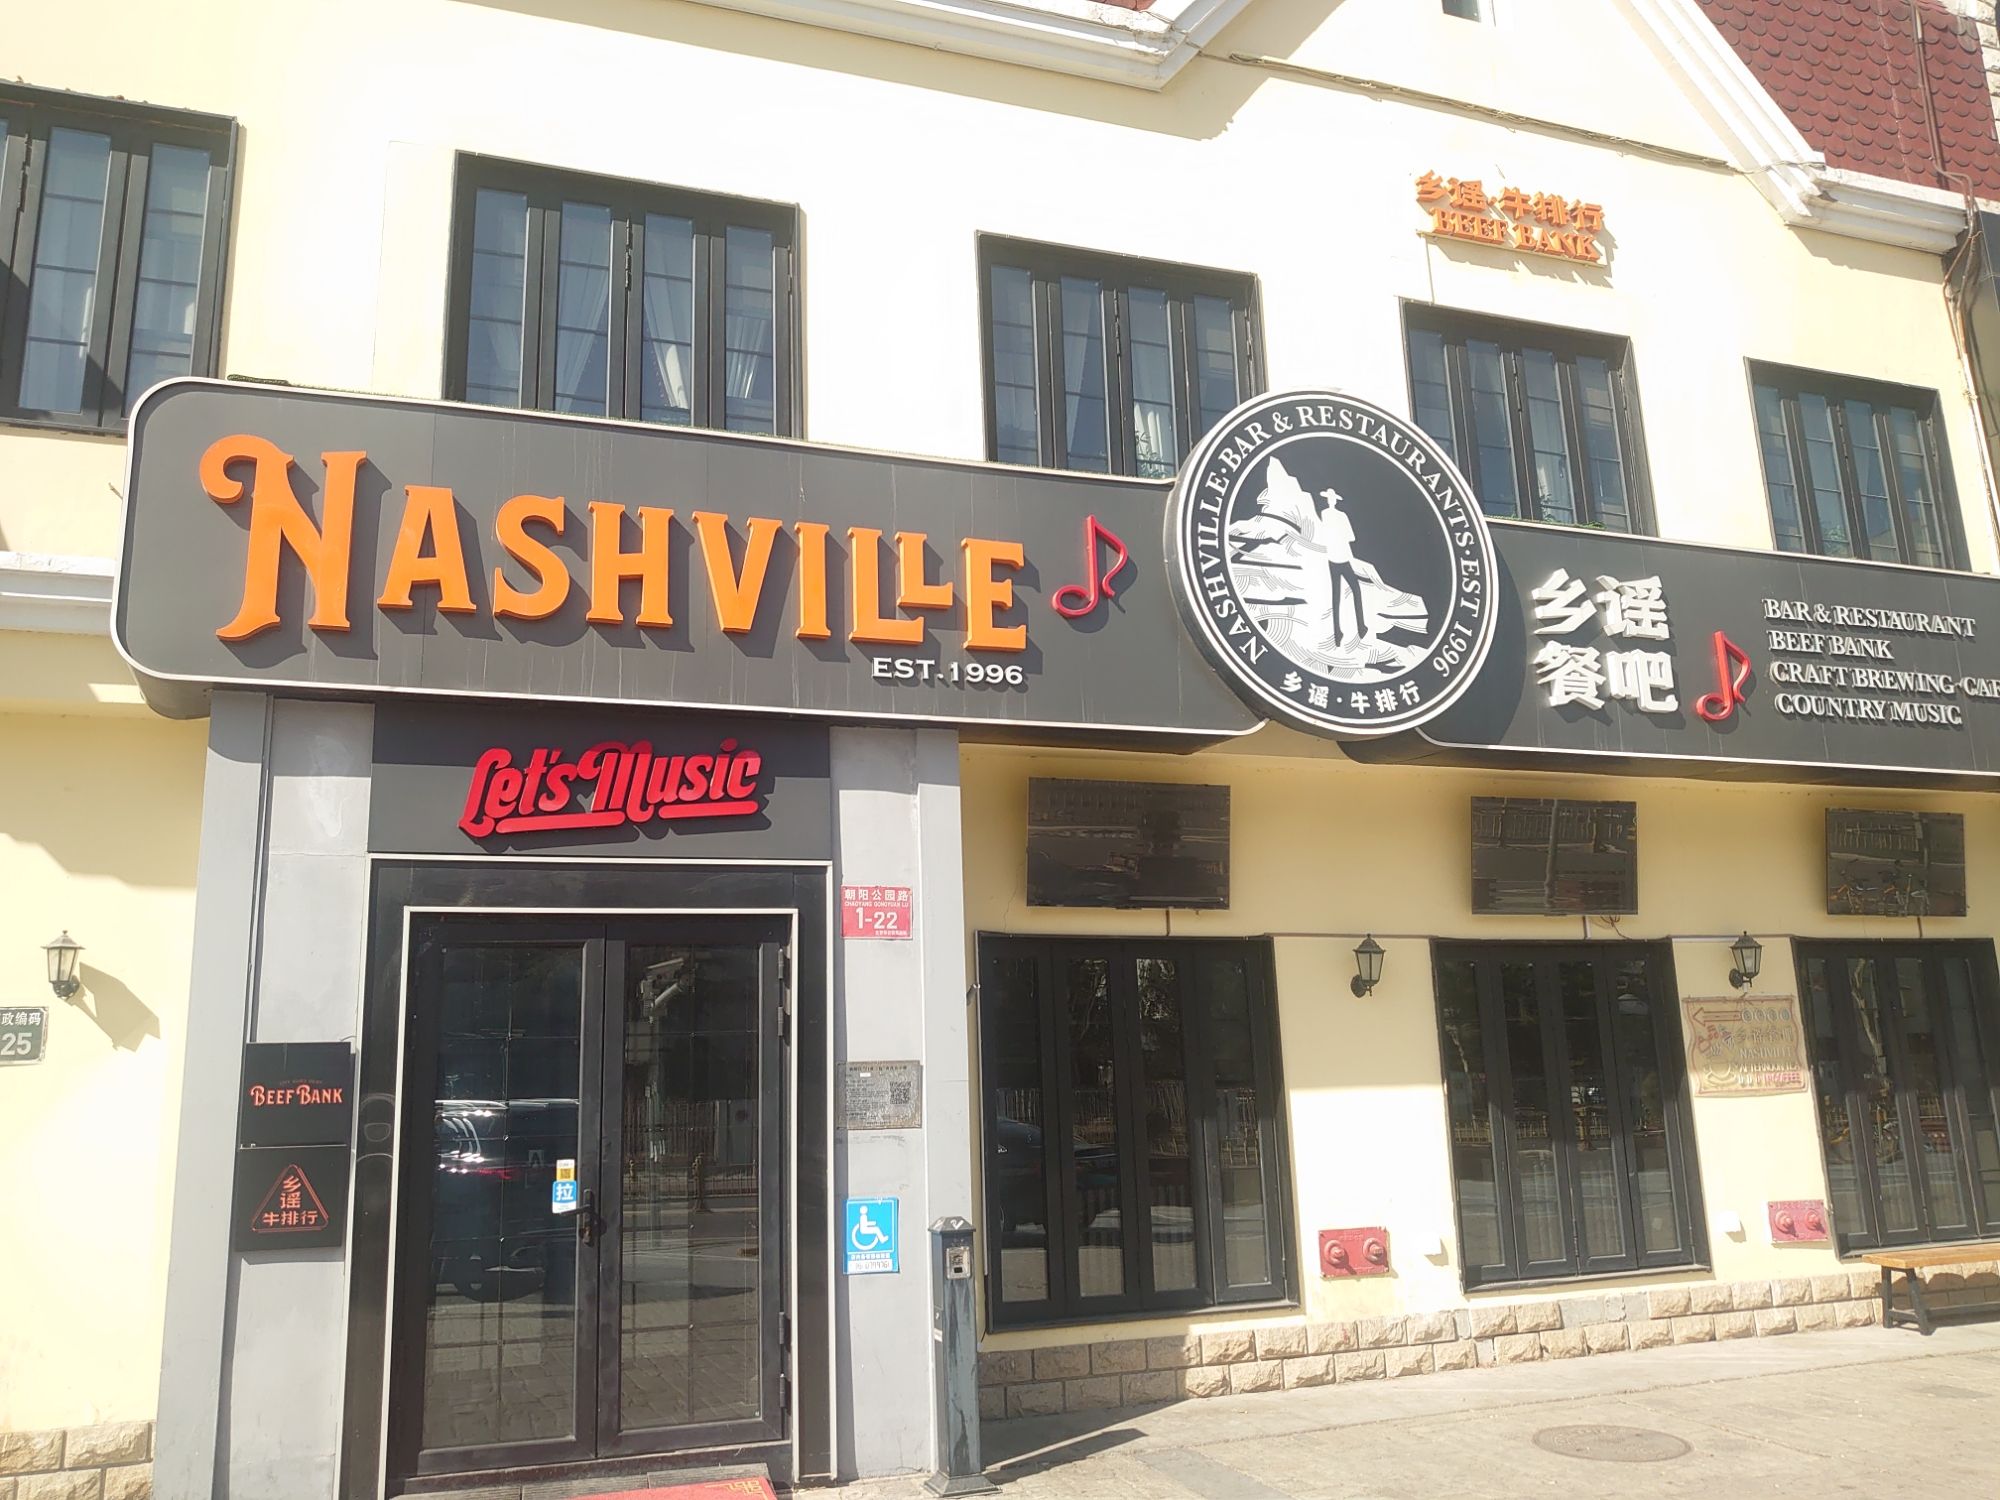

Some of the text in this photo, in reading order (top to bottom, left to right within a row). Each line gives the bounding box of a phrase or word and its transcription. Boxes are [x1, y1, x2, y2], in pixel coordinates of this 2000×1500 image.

[1430, 207, 1600, 262] BEEF BANK
[199, 434, 1027, 652] NASHVILLE
[1272, 411, 1293, 433] &
[1432, 620, 1473, 677] 1996
[1531, 567, 1671, 642] 乡谣
[1767, 630, 1895, 660] BEEF BANK
[1530, 639, 1678, 713] 餐吧
[1770, 660, 1848, 686] CRAFT
[1775, 693, 1963, 725] COUNTRY MUSIC
[458, 738, 762, 837] Let's Music
[844, 889, 909, 901] 朝阳公园路
[856, 907, 898, 929] 1-22
[0, 1012, 41, 1026] 政编码
[0, 1032, 32, 1055] 25
[251, 1085, 343, 1106] BEEF BANK
[556, 1183, 574, 1201] 拉
[262, 1211, 318, 1226] 牛排行
